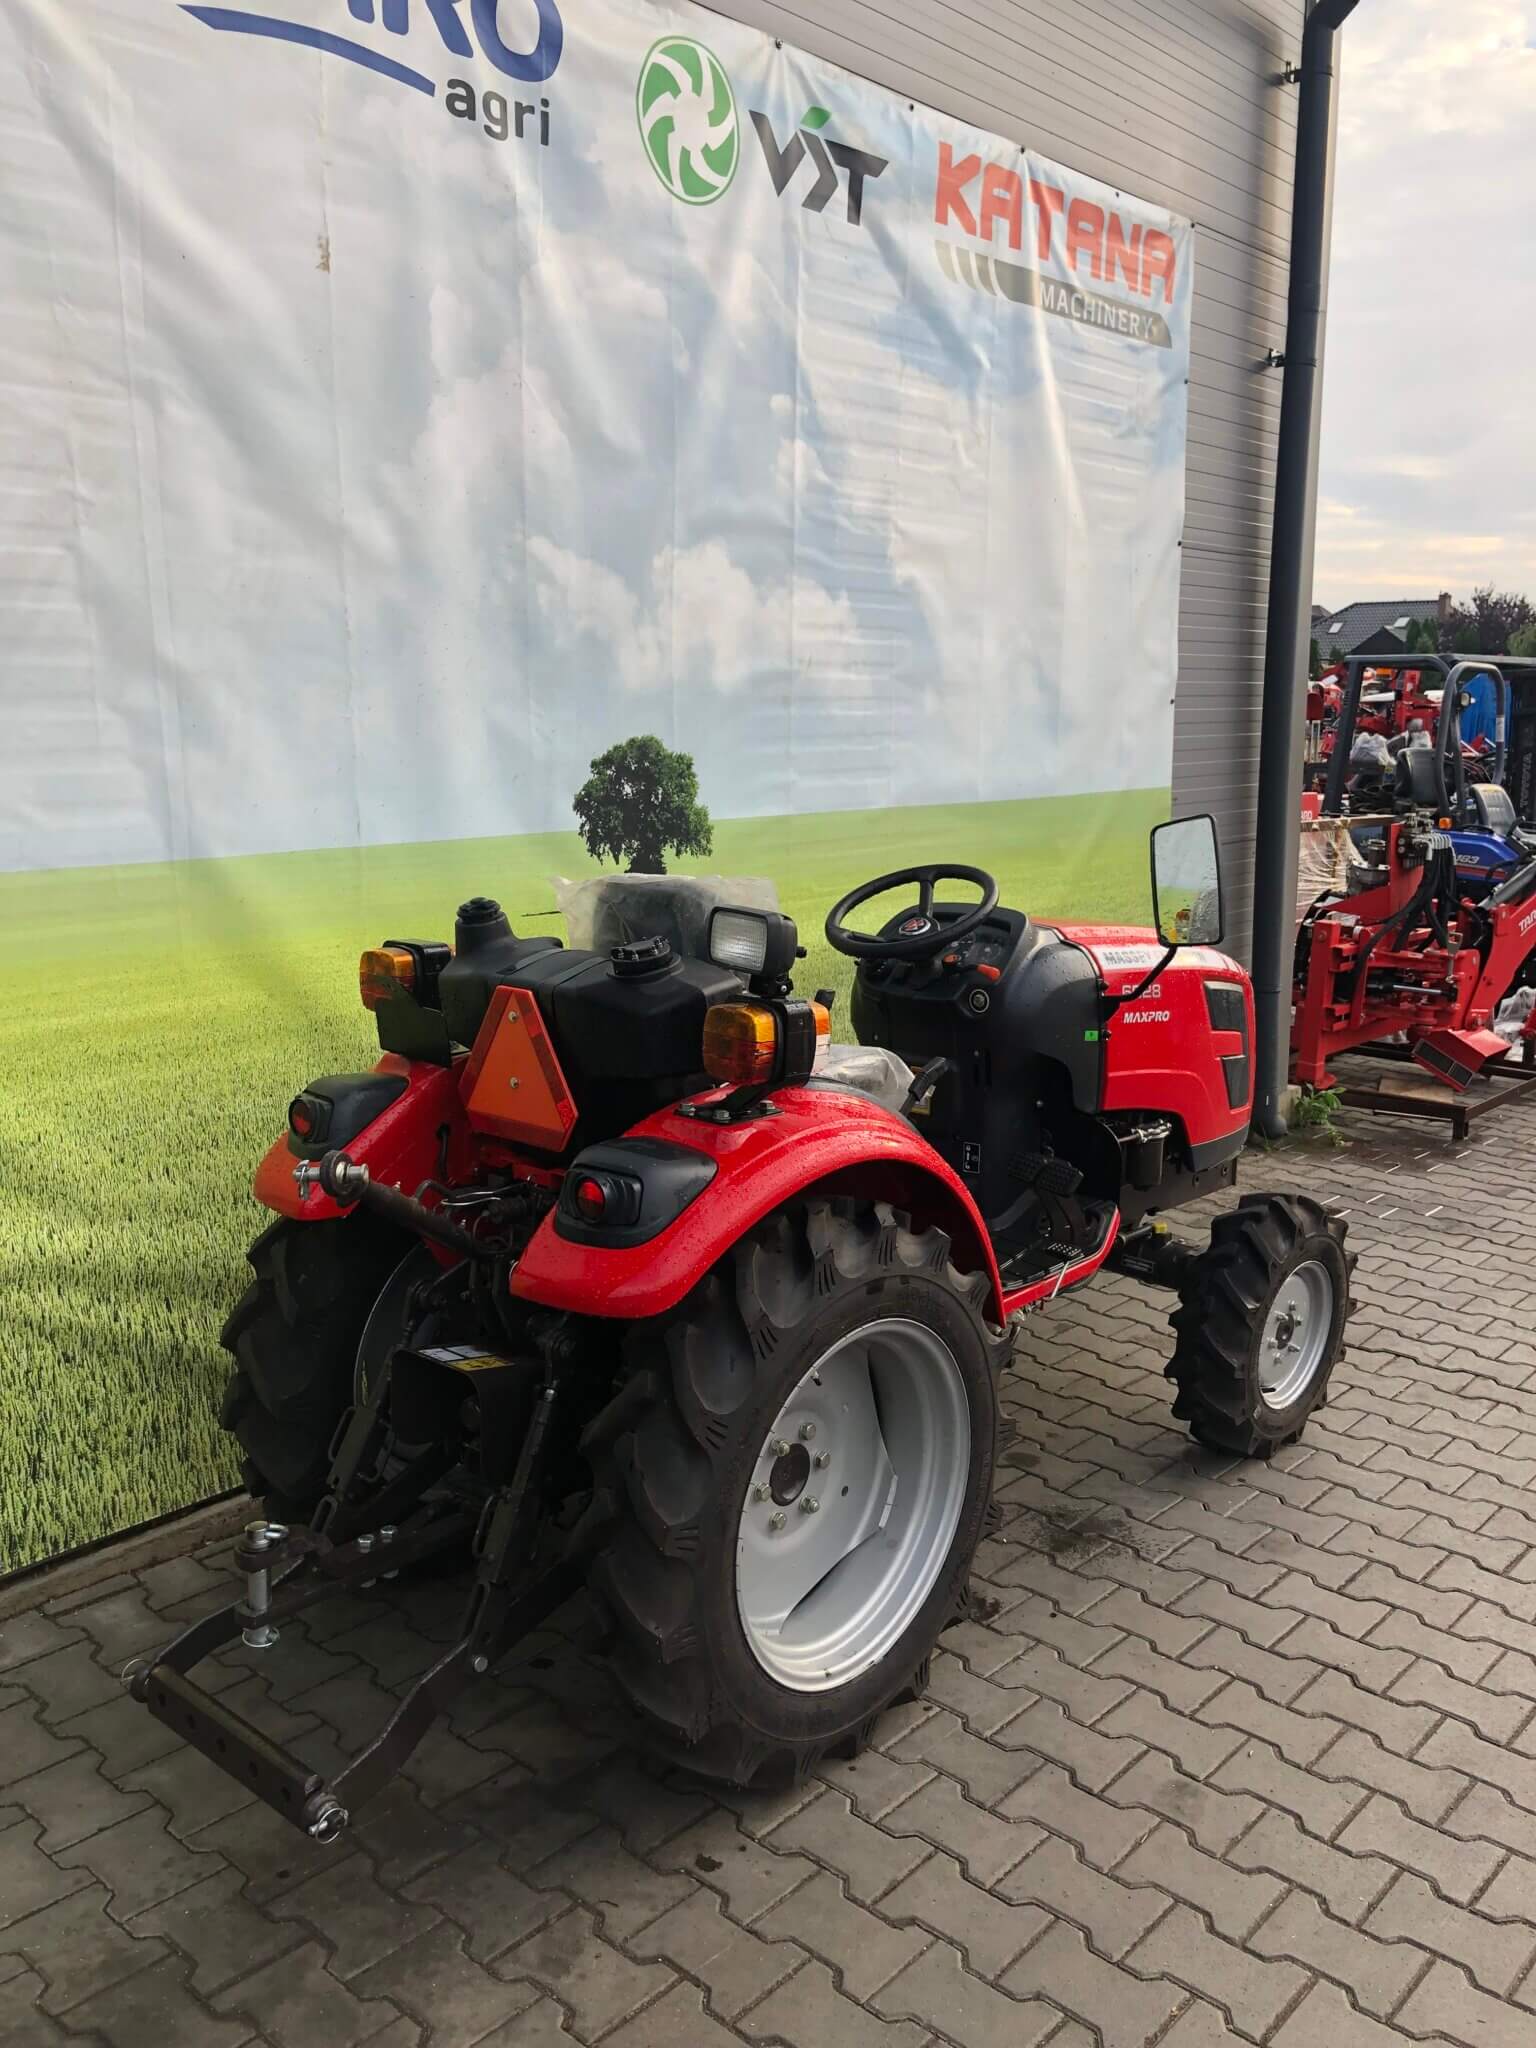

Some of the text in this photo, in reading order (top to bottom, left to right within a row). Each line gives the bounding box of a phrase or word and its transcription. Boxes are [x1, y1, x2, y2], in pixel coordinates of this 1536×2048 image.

[445, 78, 550, 146] agri
[934, 140, 1177, 304] KATANA
[1040, 281, 1154, 339] MACHINERY
[1123, 1010, 1170, 1024] MAXPRO
